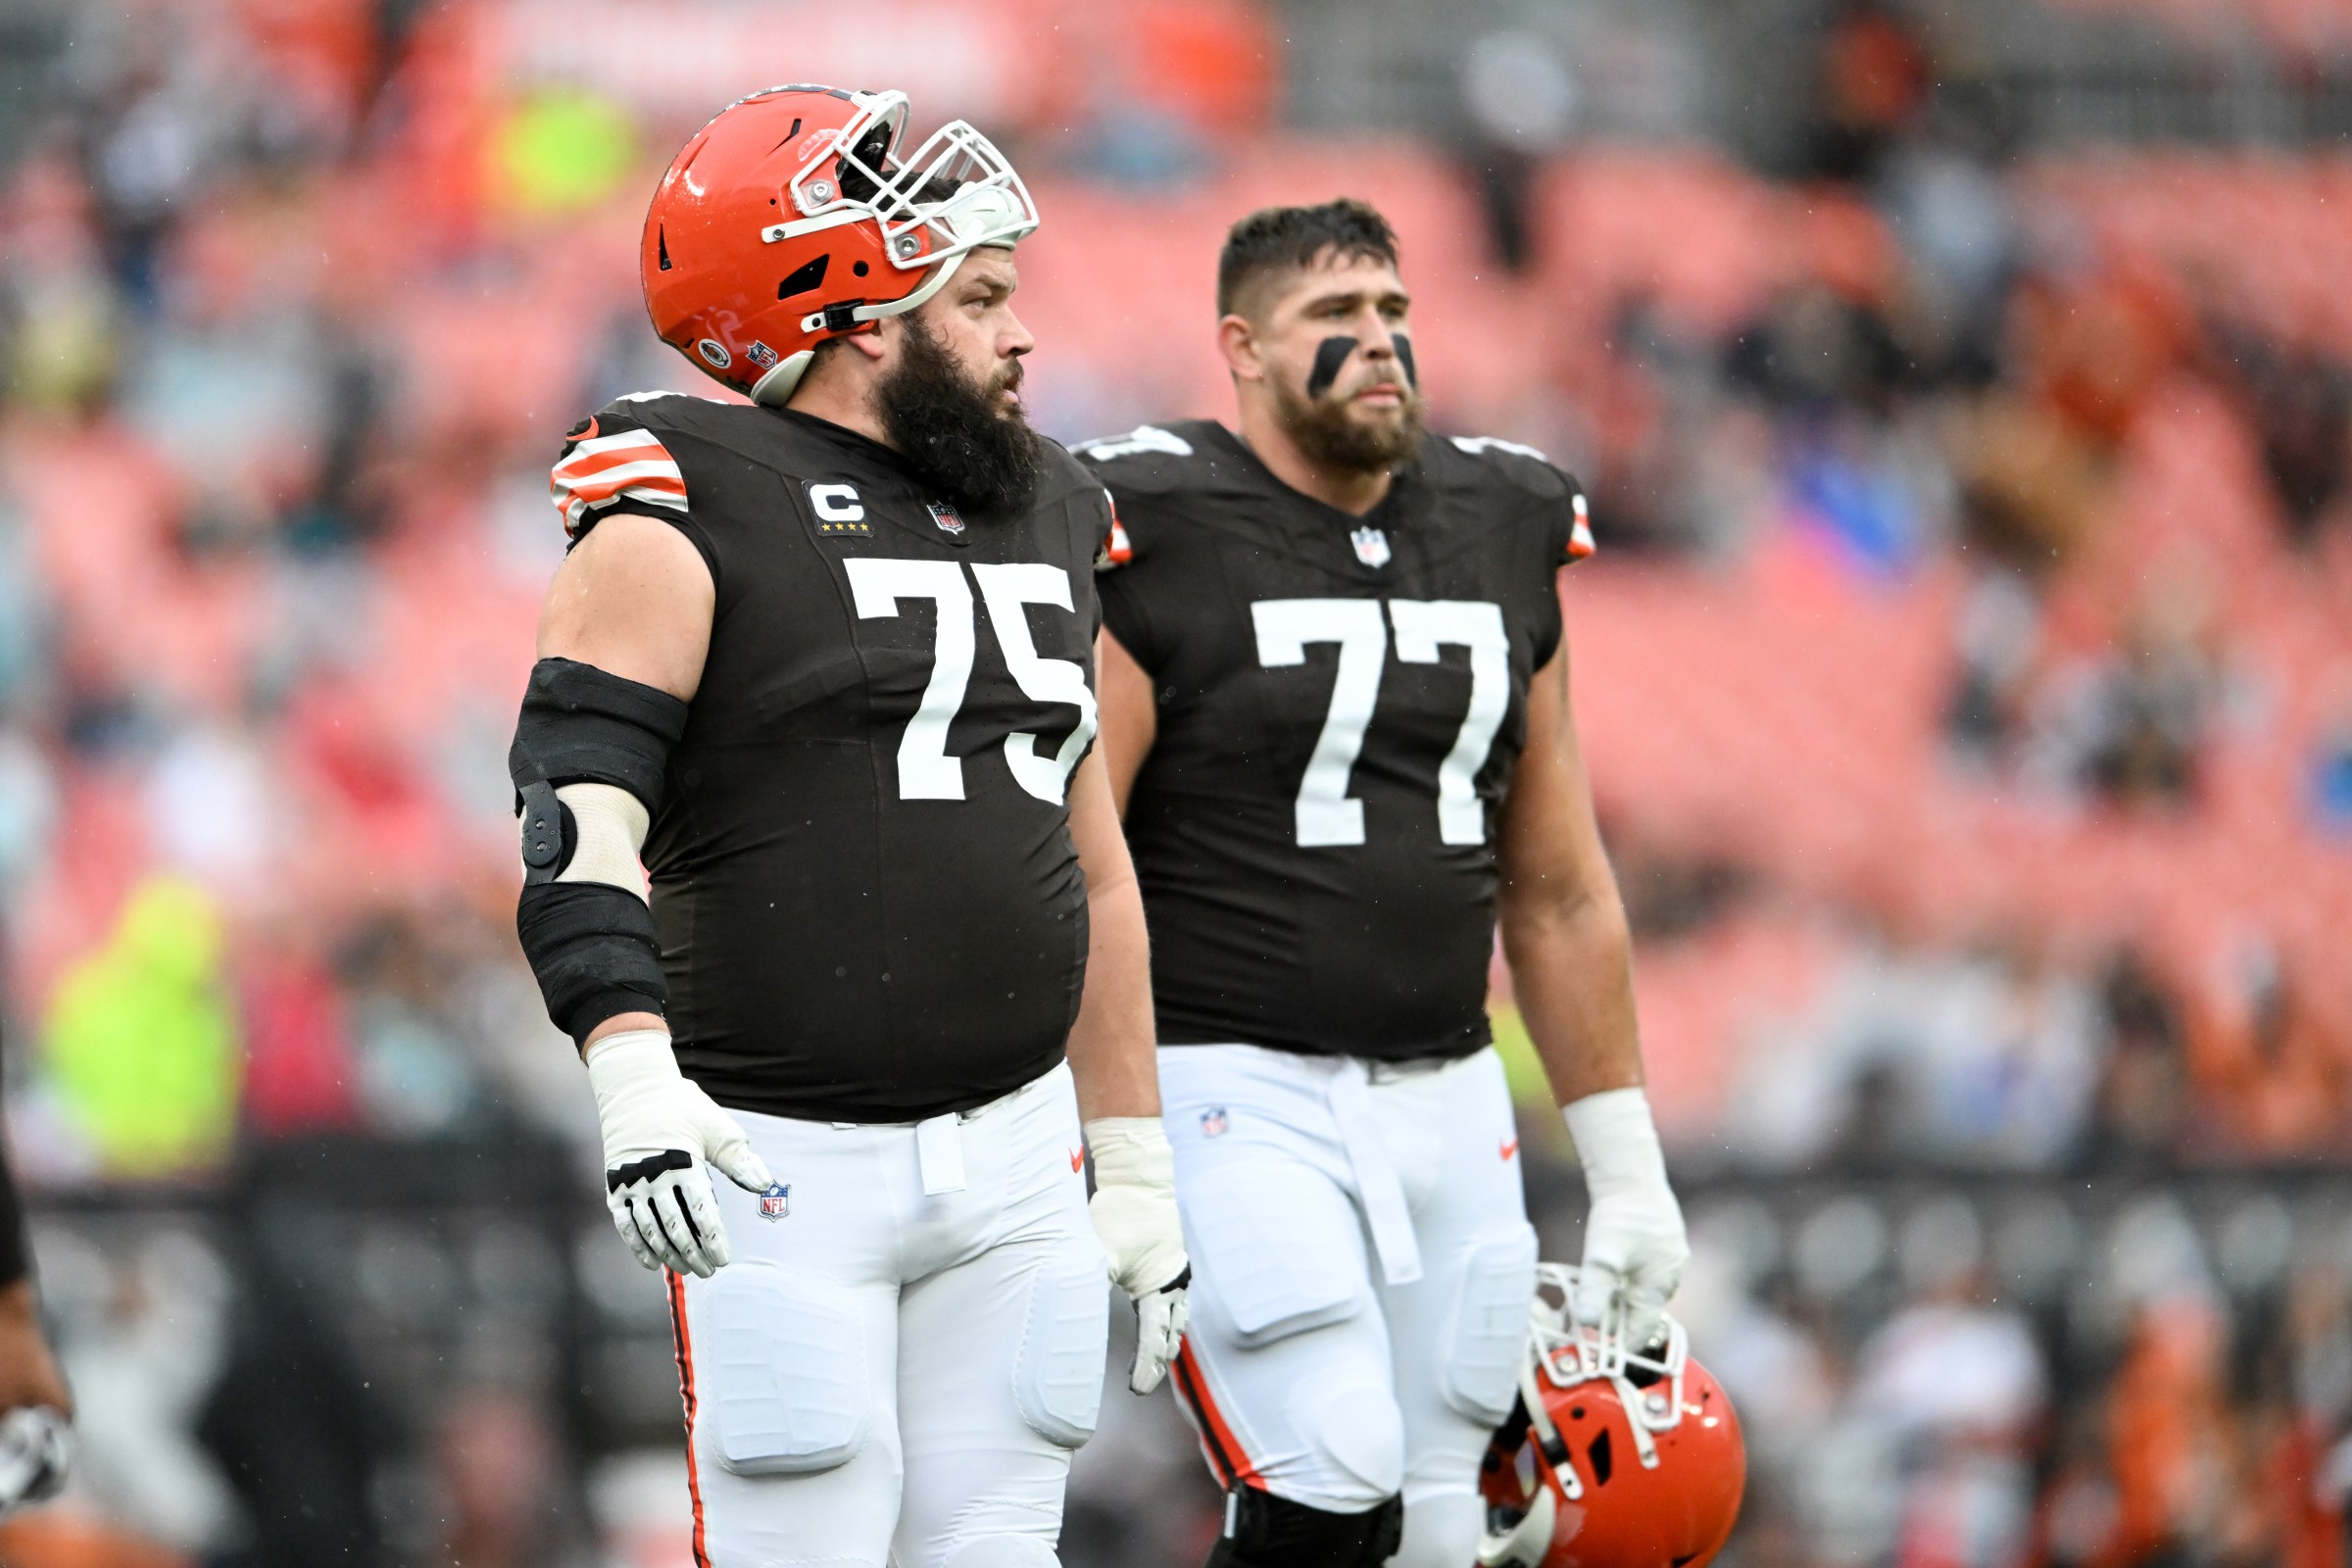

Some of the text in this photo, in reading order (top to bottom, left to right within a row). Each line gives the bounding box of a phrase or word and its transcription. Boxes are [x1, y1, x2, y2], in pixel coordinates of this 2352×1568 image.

[809, 483, 864, 521] C
[843, 558, 1097, 806] 75
[1250, 599, 1510, 847] 77
[762, 1198, 785, 1214] NFL
